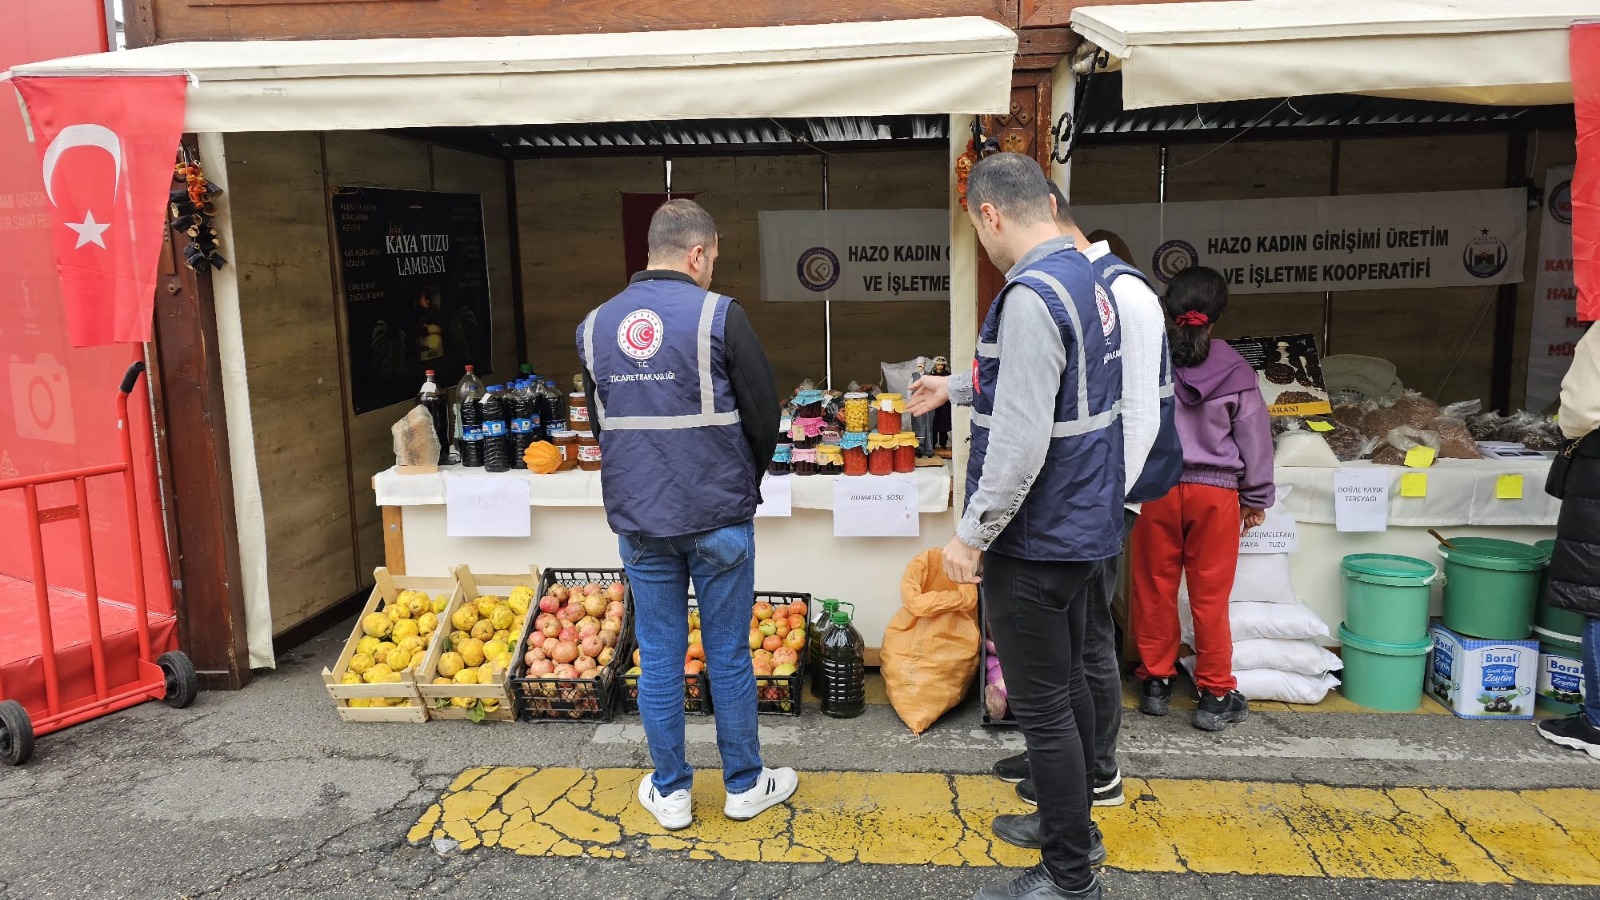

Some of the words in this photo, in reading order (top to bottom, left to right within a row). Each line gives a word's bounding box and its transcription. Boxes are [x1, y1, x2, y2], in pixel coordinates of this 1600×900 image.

[385, 234, 418, 254] KAYA
[420, 234, 449, 252] TUZU
[1208, 237, 1250, 254] HAZO
[1256, 234, 1307, 253] KADIN
[1312, 228, 1380, 254] GİRİŞİMİ
[1386, 226, 1449, 248] ÜRETİM
[849, 246, 889, 262] HAZO
[894, 245, 941, 262] KADIN
[396, 256, 446, 276] LAMBASI
[1224, 268, 1244, 284] VE
[1250, 264, 1318, 288] İŞLETME
[1322, 257, 1430, 281] KOOPERATİFİ
[863, 276, 882, 292] VE
[888, 272, 950, 295] İŞLETME
[610, 373, 639, 382] TİCARET
[640, 370, 676, 381] BAKANLIĞI
[1435, 636, 1453, 654] Boral
[1485, 653, 1516, 663] Boral
[1485, 674, 1512, 684] Zeytin
